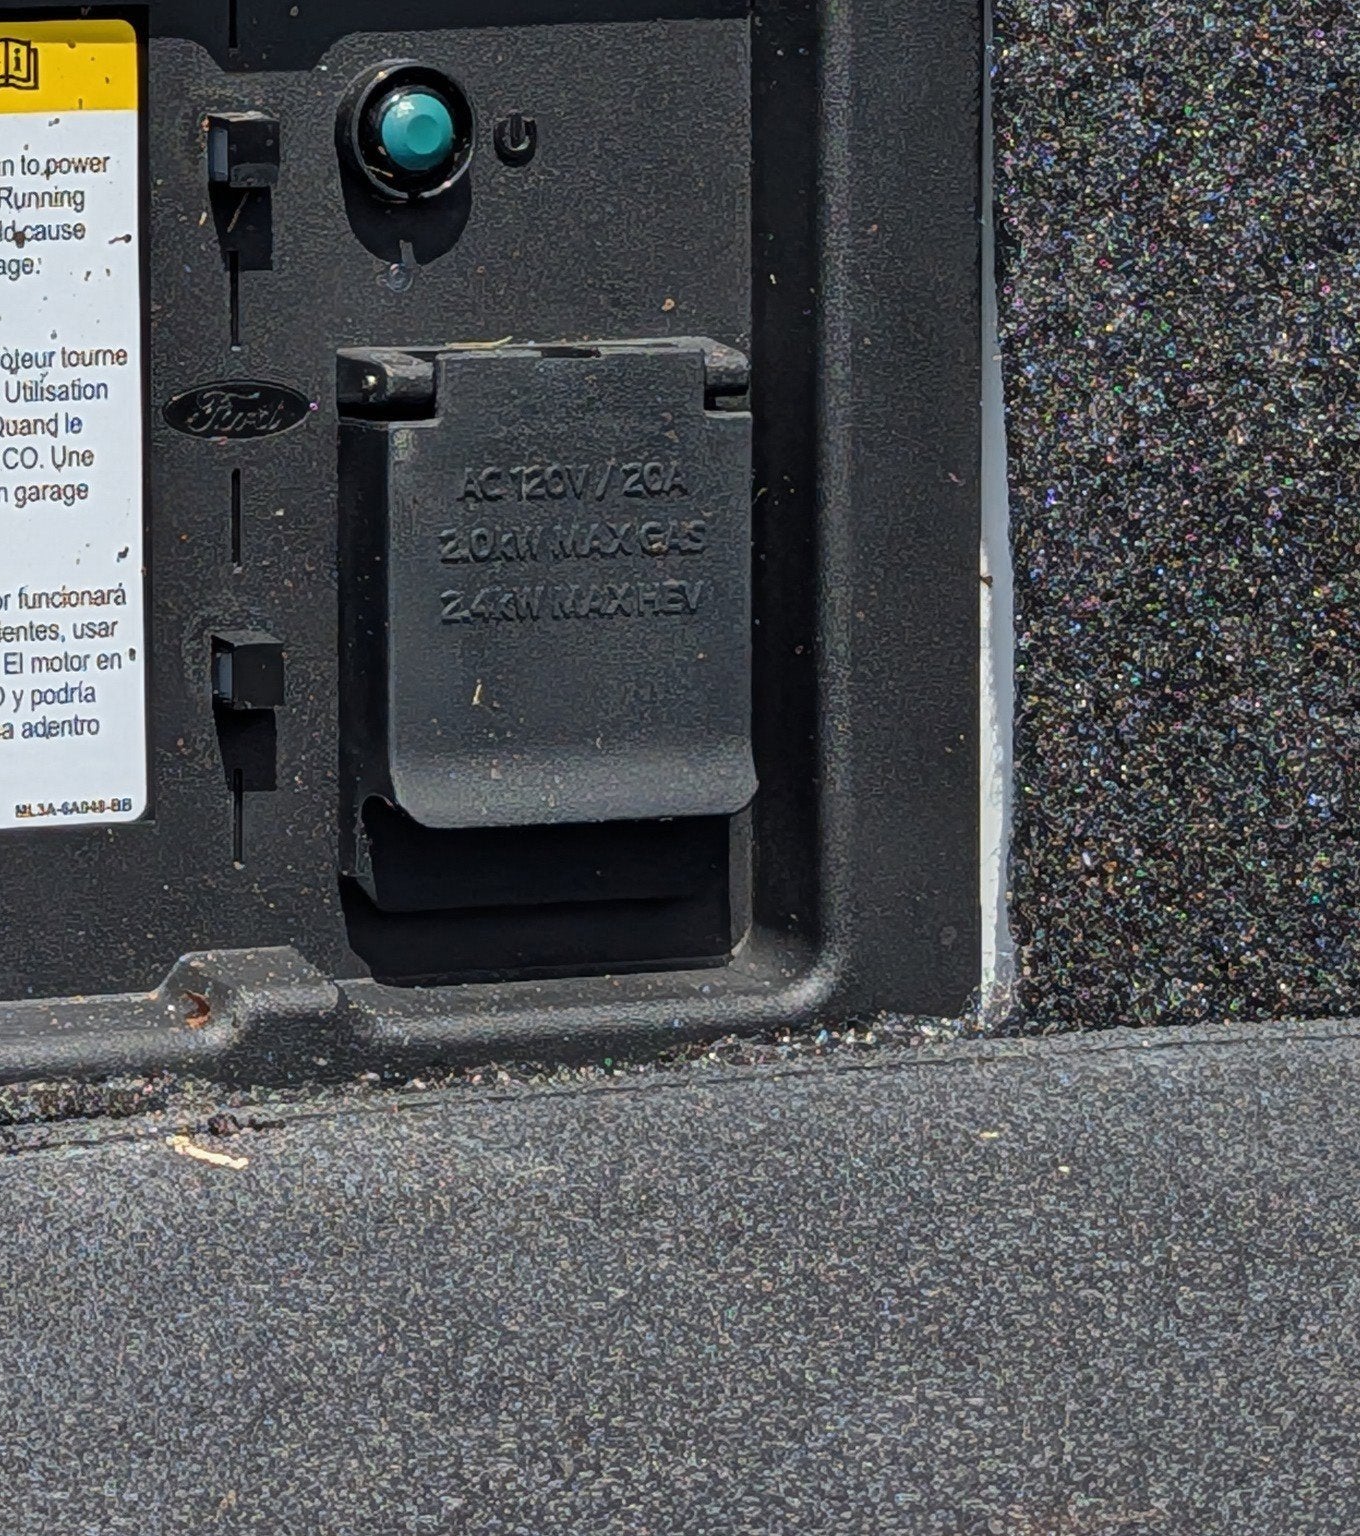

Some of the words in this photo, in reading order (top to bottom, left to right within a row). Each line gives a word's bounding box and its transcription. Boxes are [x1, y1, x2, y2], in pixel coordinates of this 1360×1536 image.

[21, 155, 38, 175] to
[44, 157, 110, 179] power
[24, 223, 85, 241] cause
[61, 348, 127, 367] tourne
[5, 378, 108, 403] Utilisation
[65, 413, 82, 434] le
[2, 447, 44, 469] CO.
[51, 445, 94, 467] Une
[457, 465, 506, 501] AC
[510, 464, 589, 501] 120V
[621, 463, 691, 497] 20A
[15, 483, 88, 507] garage
[551, 522, 632, 559] MAX
[641, 519, 707, 557] GAS
[18, 583, 126, 611] funcionará
[551, 582, 630, 620] MAX
[637, 579, 705, 616] HEV
[73, 619, 118, 640] usar
[4, 653, 22, 674] El
[31, 651, 90, 672] motor
[97, 651, 121, 670] en
[13, 689, 23, 712] y
[30, 682, 96, 711] podría
[22, 715, 100, 739] adentro
